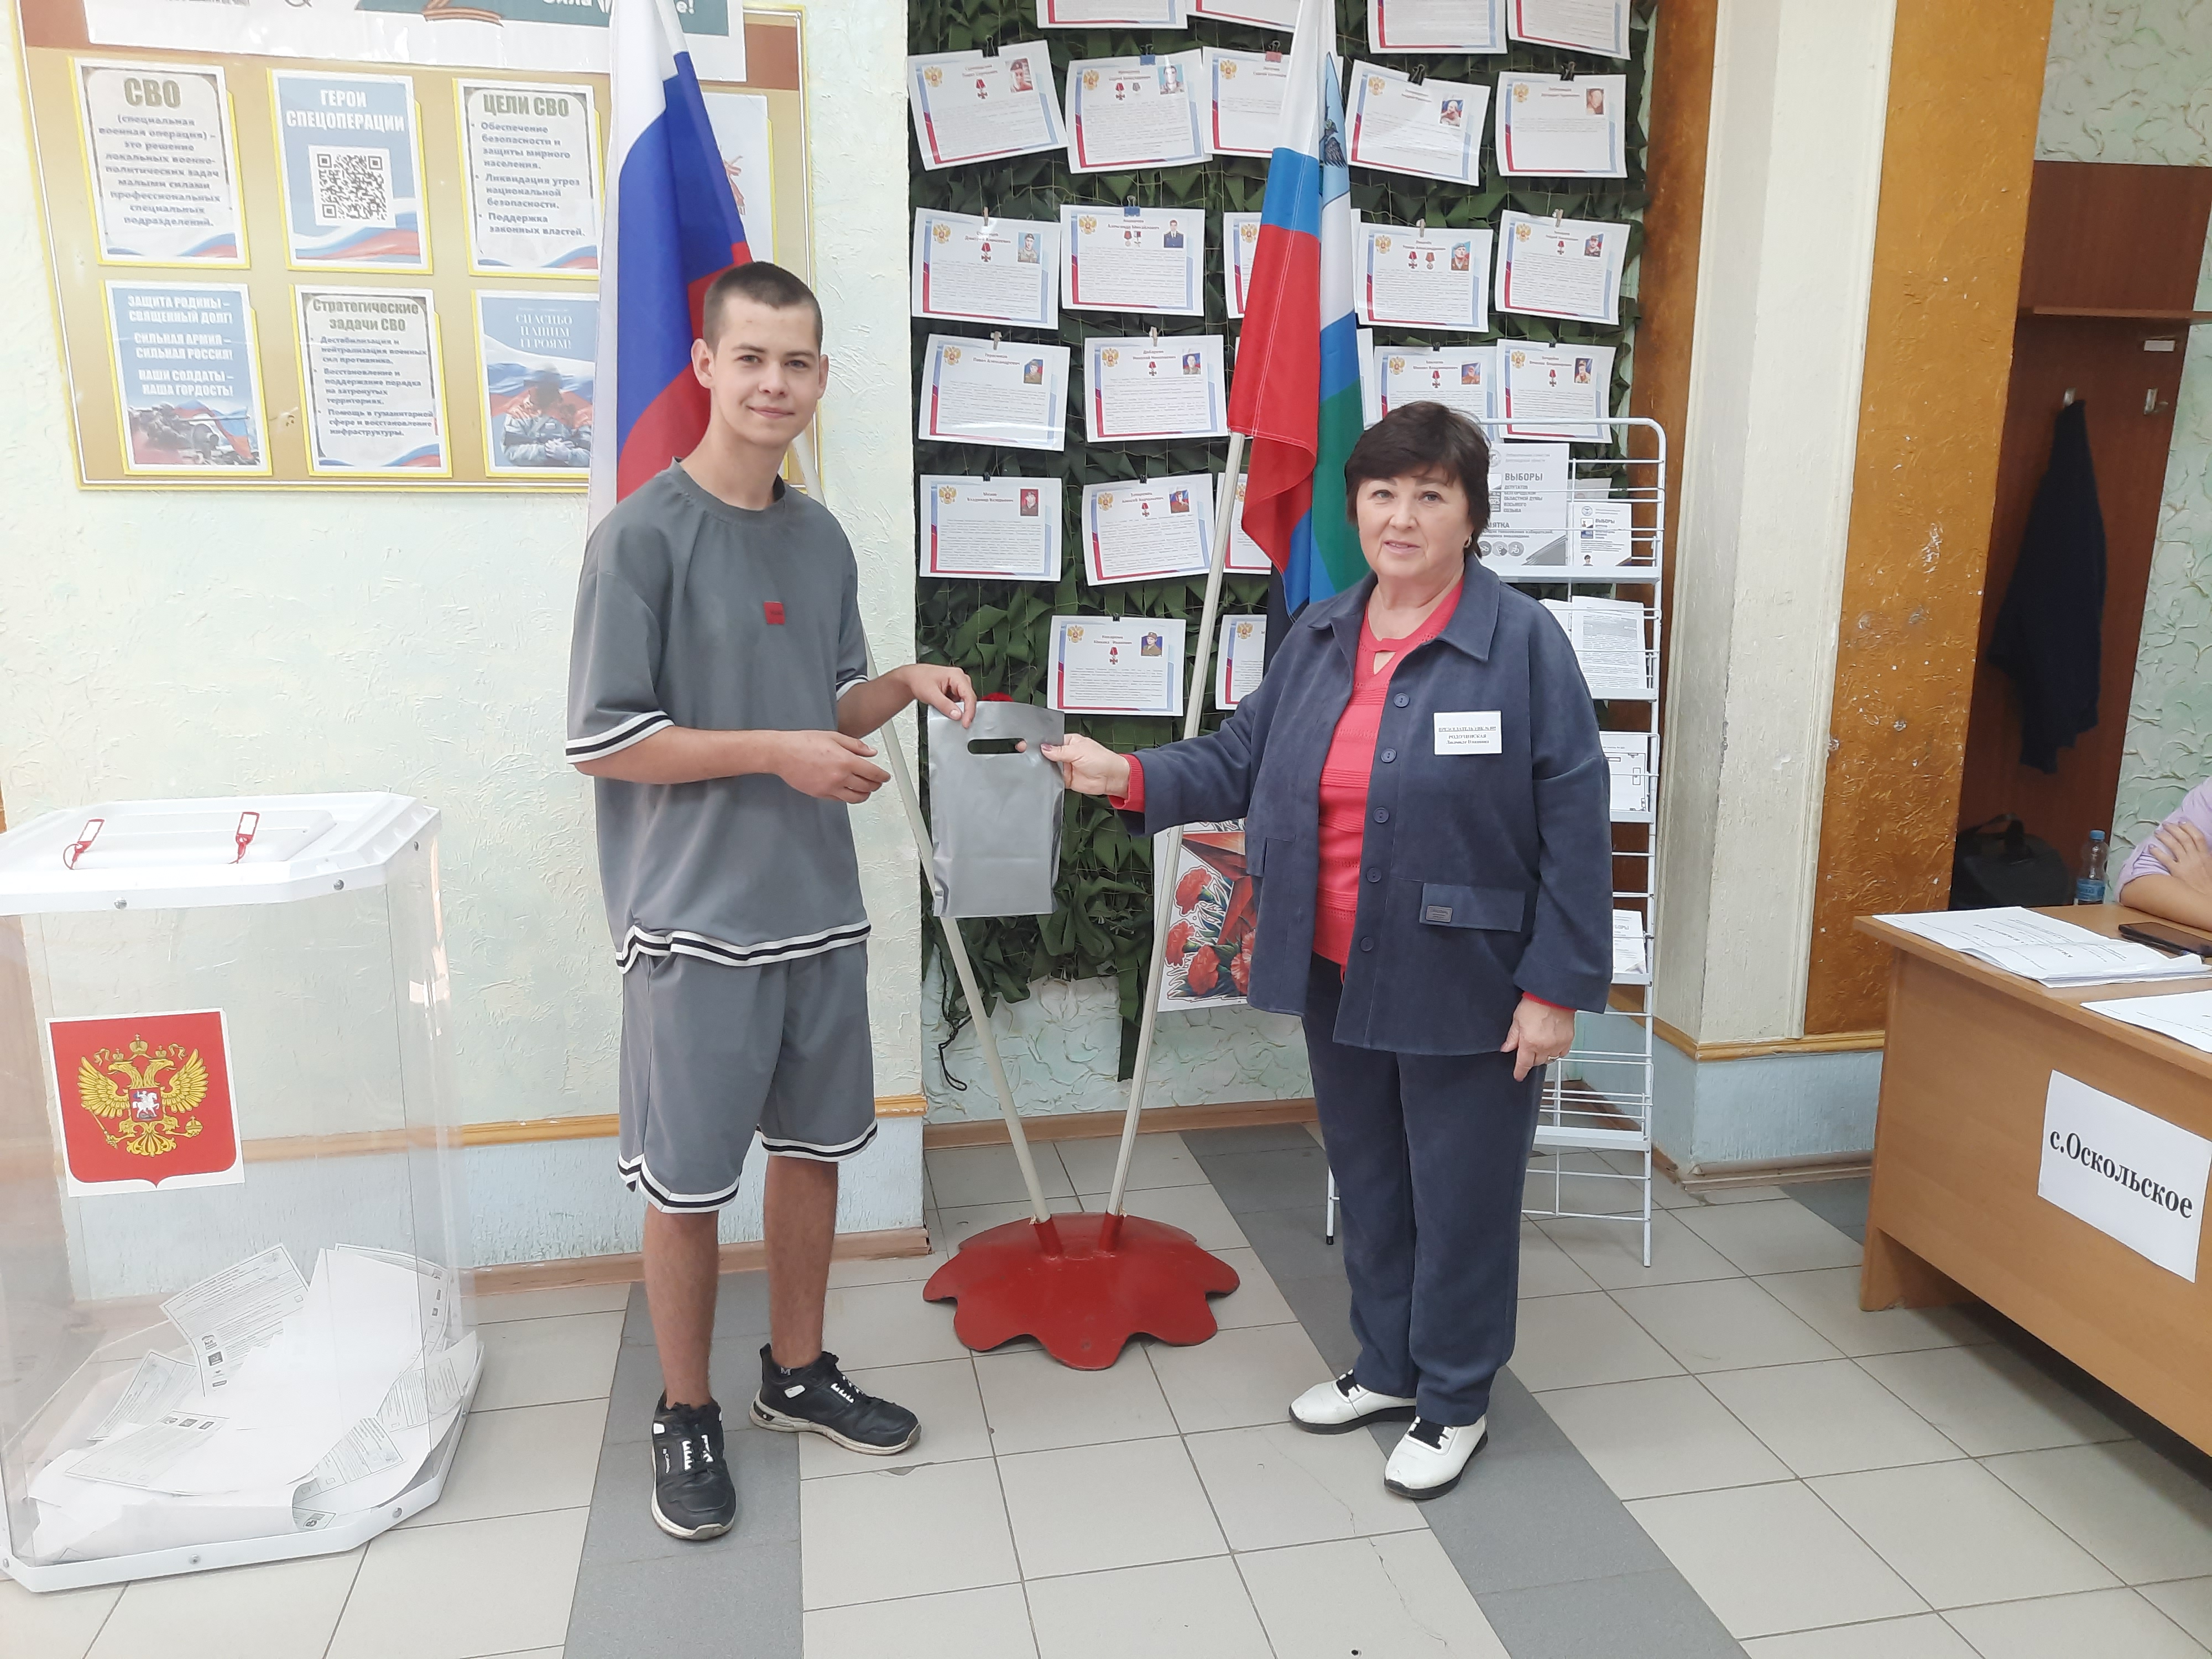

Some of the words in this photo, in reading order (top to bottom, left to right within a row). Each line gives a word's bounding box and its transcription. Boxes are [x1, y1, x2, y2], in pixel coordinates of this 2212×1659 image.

[124, 77, 181, 108] СВО
[320, 89, 367, 108] ГЕРОИ
[483, 93, 530, 117] ЦЕЛИ
[534, 97, 570, 117] СВО
[117, 114, 195, 126] (специальная
[286, 109, 405, 133] СПЕЦОПЕРАЦИИ
[98, 127, 145, 136] военная
[149, 130, 207, 140] операция)
[481, 122, 548, 133] Обеспечение
[482, 134, 551, 145] безопасности
[145, 142, 194, 152] решение
[106, 153, 169, 163] локальных
[483, 148, 523, 156] защиты
[526, 150, 570, 159] мирного
[484, 159, 541, 169] населения.
[106, 166, 185, 175] политических
[486, 173, 549, 185] Ликвидация
[552, 178, 580, 187] угроз
[111, 191, 220, 202] профессиональных
[486, 186, 561, 196] национальной
[487, 197, 559, 208] безопасности.
[129, 205, 205, 214] специальных
[124, 216, 213, 227] подразделений.
[488, 212, 548, 224] Поддержка
[489, 226, 540, 234] законных
[543, 228, 585, 236] властей.
[128, 295, 173, 309] ЗАЩИТА
[174, 296, 222, 309] РОДИНЫ
[313, 299, 419, 315] Стратегические
[129, 310, 199, 324] СВЯЩЕННЫЙ
[201, 311, 233, 325] ДОЛГ!
[515, 314, 573, 325] СПАСИБО
[330, 319, 378, 332] задачи
[380, 318, 406, 331] СВО
[520, 326, 571, 337] НАШИМ
[134, 332, 184, 345] СИЛЬНАЯ
[186, 333, 223, 346] АРМИЯ
[135, 346, 186, 359] СИЛЬНАЯ
[187, 348, 233, 361] РОССИЯ!
[139, 369, 170, 381] НАШИ
[172, 369, 226, 383] СОЛДАТЫ
[142, 384, 174, 396] НАША
[176, 384, 233, 397] ГОРДОСТЬ!
[1505, 473, 1543, 481] ВЫБОРЫ
[2049, 1130, 2193, 1219] с.Оскольское
